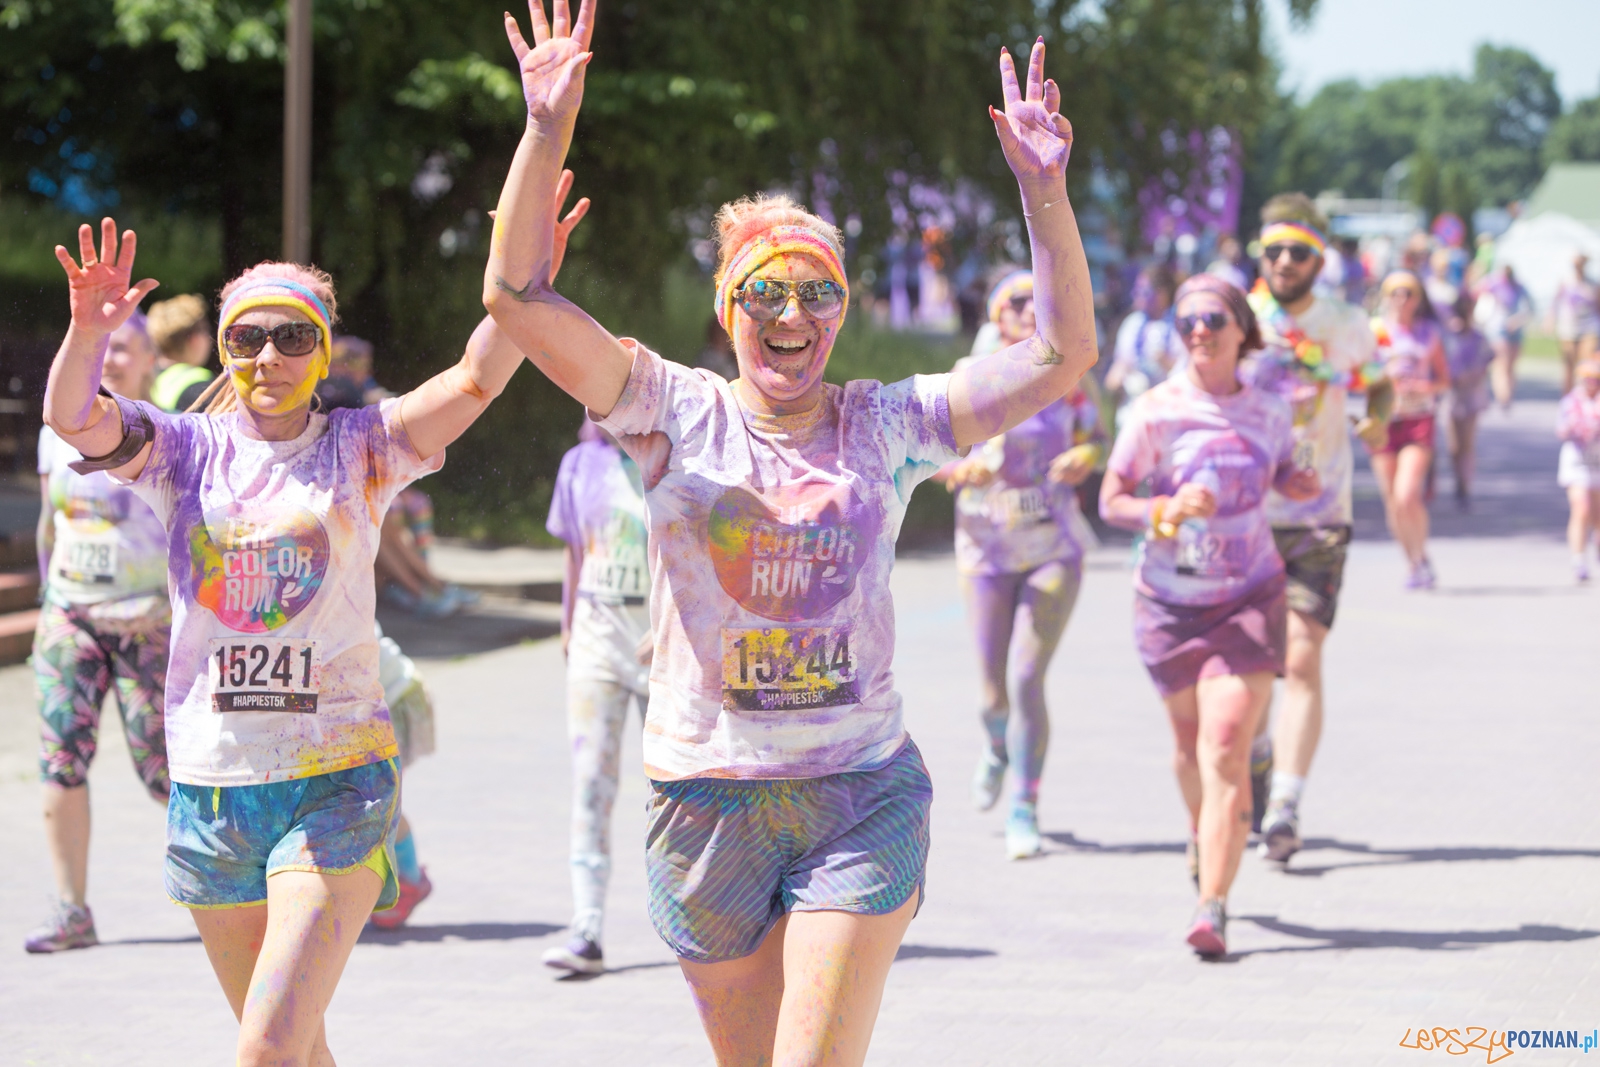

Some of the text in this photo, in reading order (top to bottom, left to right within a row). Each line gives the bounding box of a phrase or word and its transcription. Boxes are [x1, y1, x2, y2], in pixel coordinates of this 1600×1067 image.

[222, 546, 313, 579] COLOR
[751, 559, 813, 598] RUN
[225, 577, 278, 613] RUN
[216, 644, 312, 688] 15241
[233, 695, 287, 708] #HAPPIEST5K
